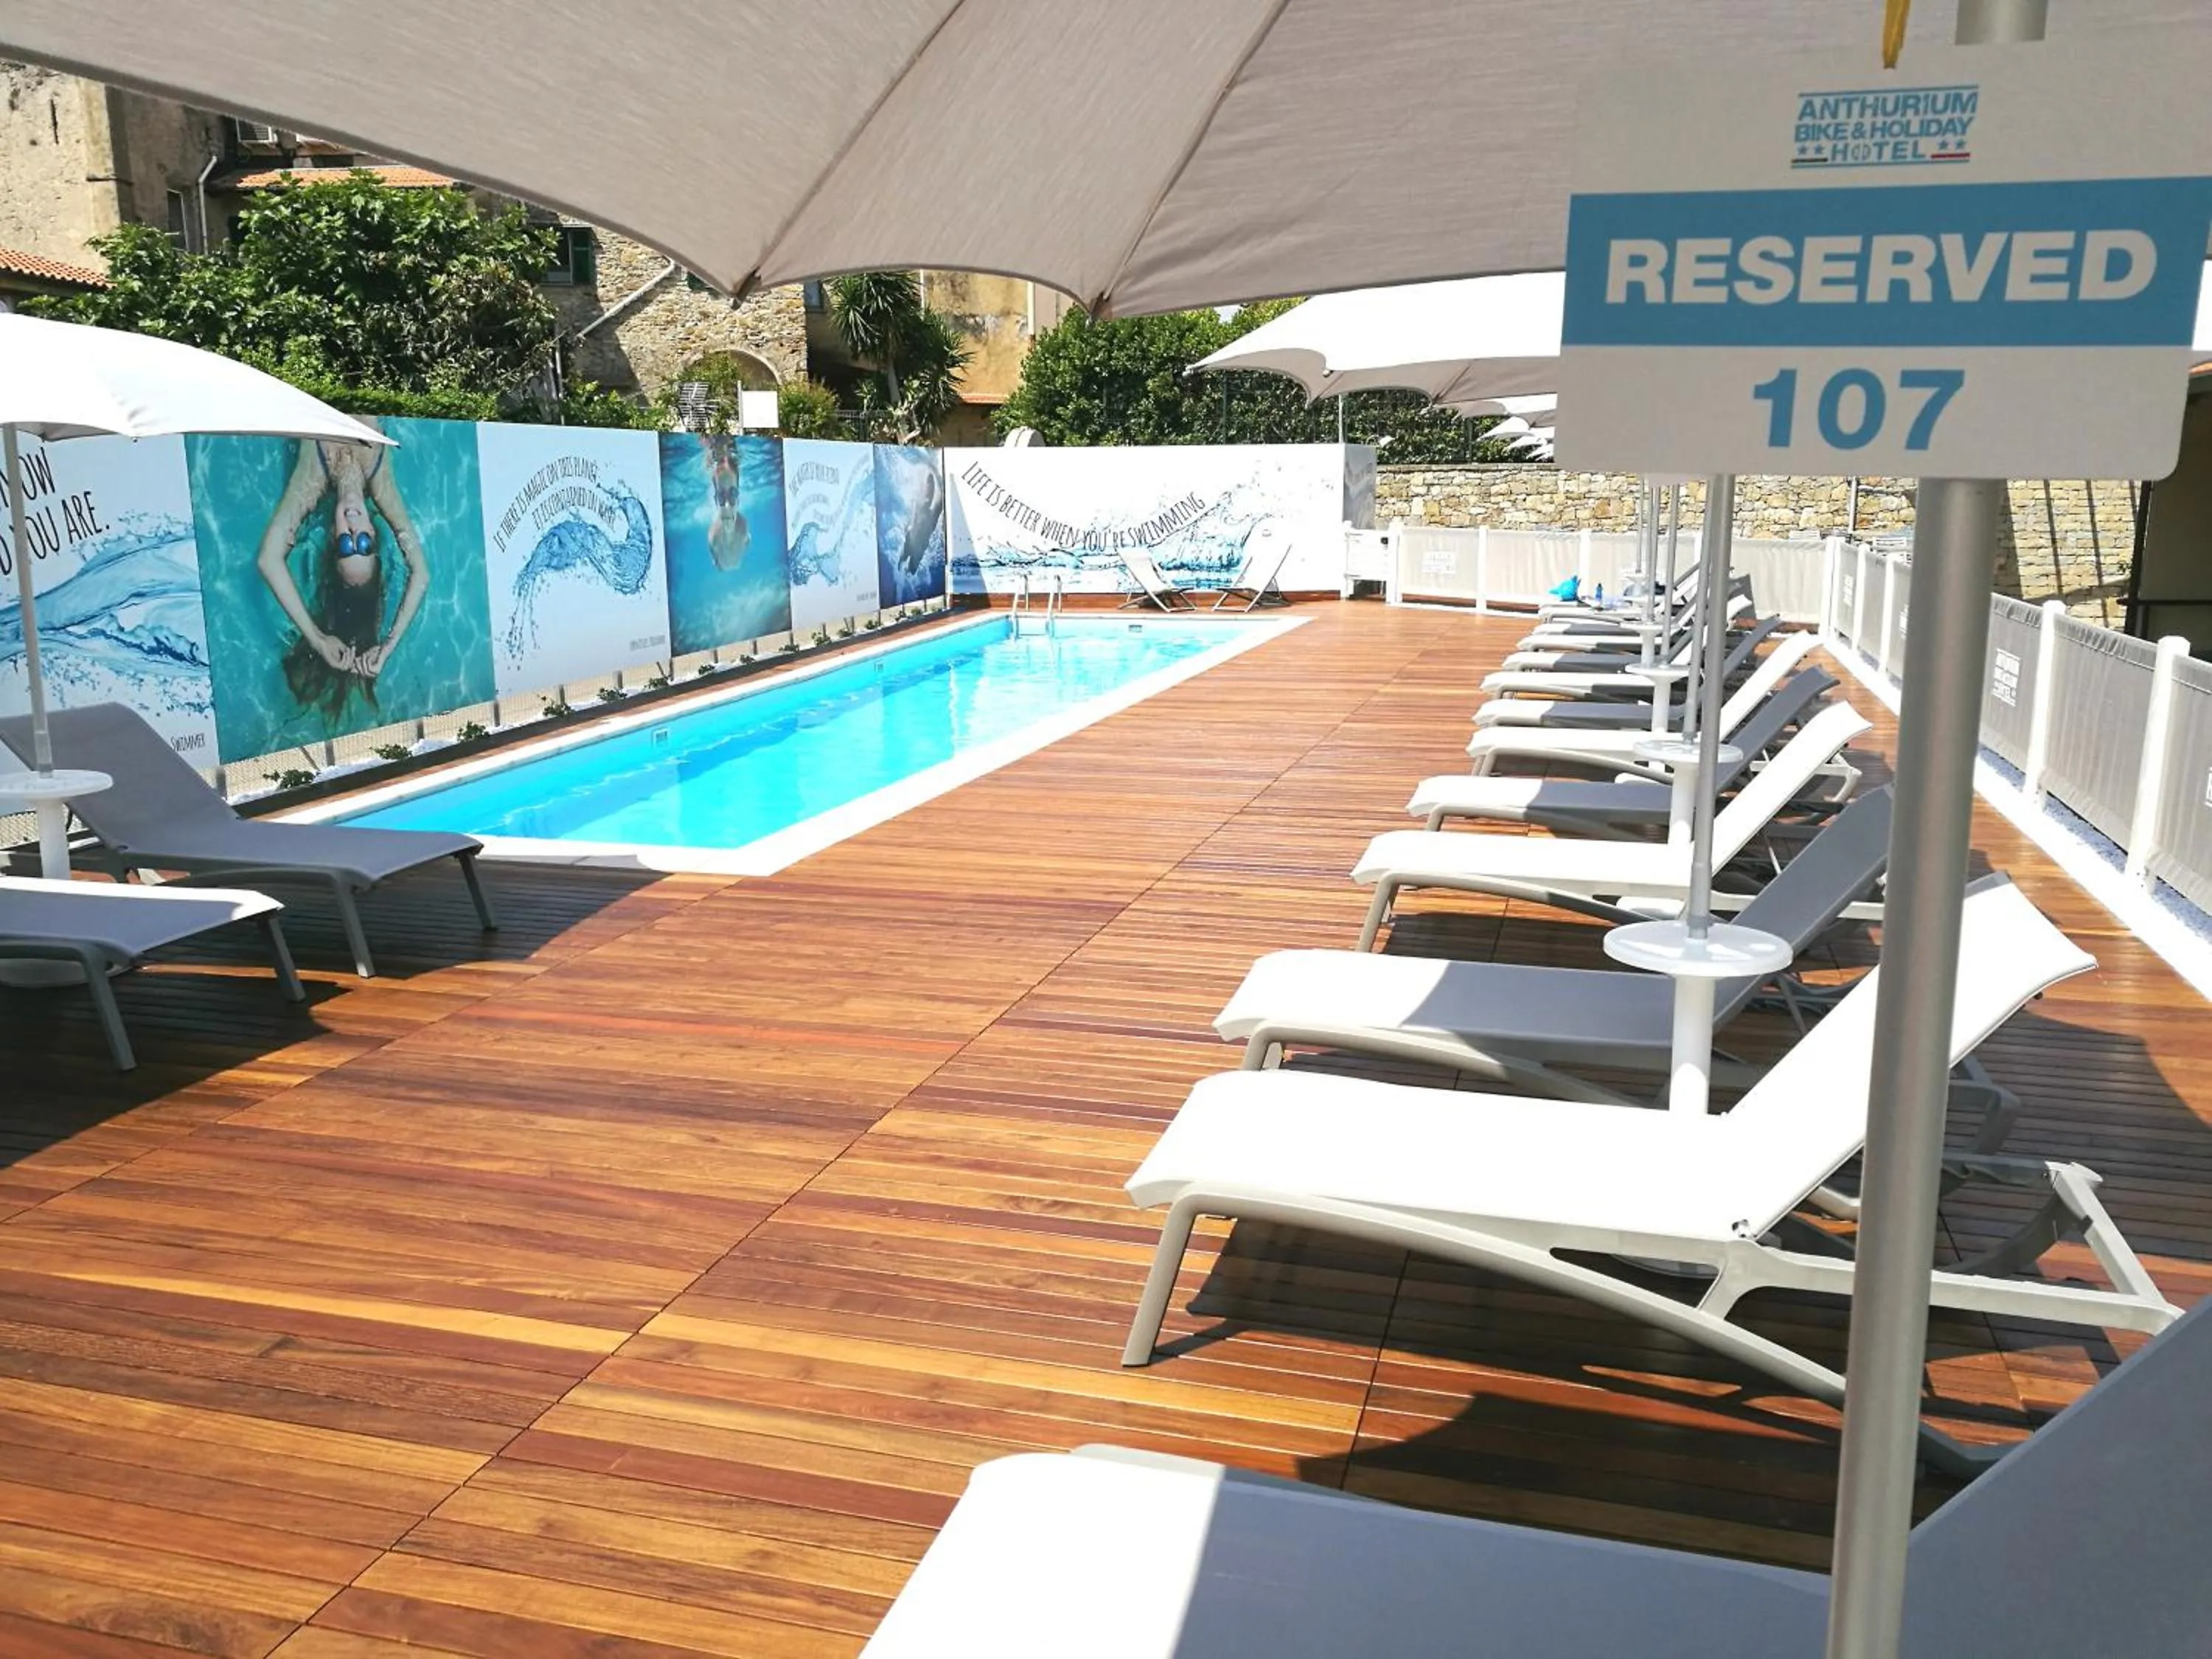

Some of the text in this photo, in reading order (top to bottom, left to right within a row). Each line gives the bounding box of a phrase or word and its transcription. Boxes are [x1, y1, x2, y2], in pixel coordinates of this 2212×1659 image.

[1798, 91, 1979, 121] ANTHURIUM
[1831, 140, 1927, 161] HOTEL
[1605, 229, 2157, 305] RESERVED
[1753, 368, 1966, 451] 107
[10, 507, 60, 560] OU
[61, 491, 110, 544] ARE.
[961, 461, 1206, 552] LIFE IS BETTER WHEN YOU'RE SWIMMING
